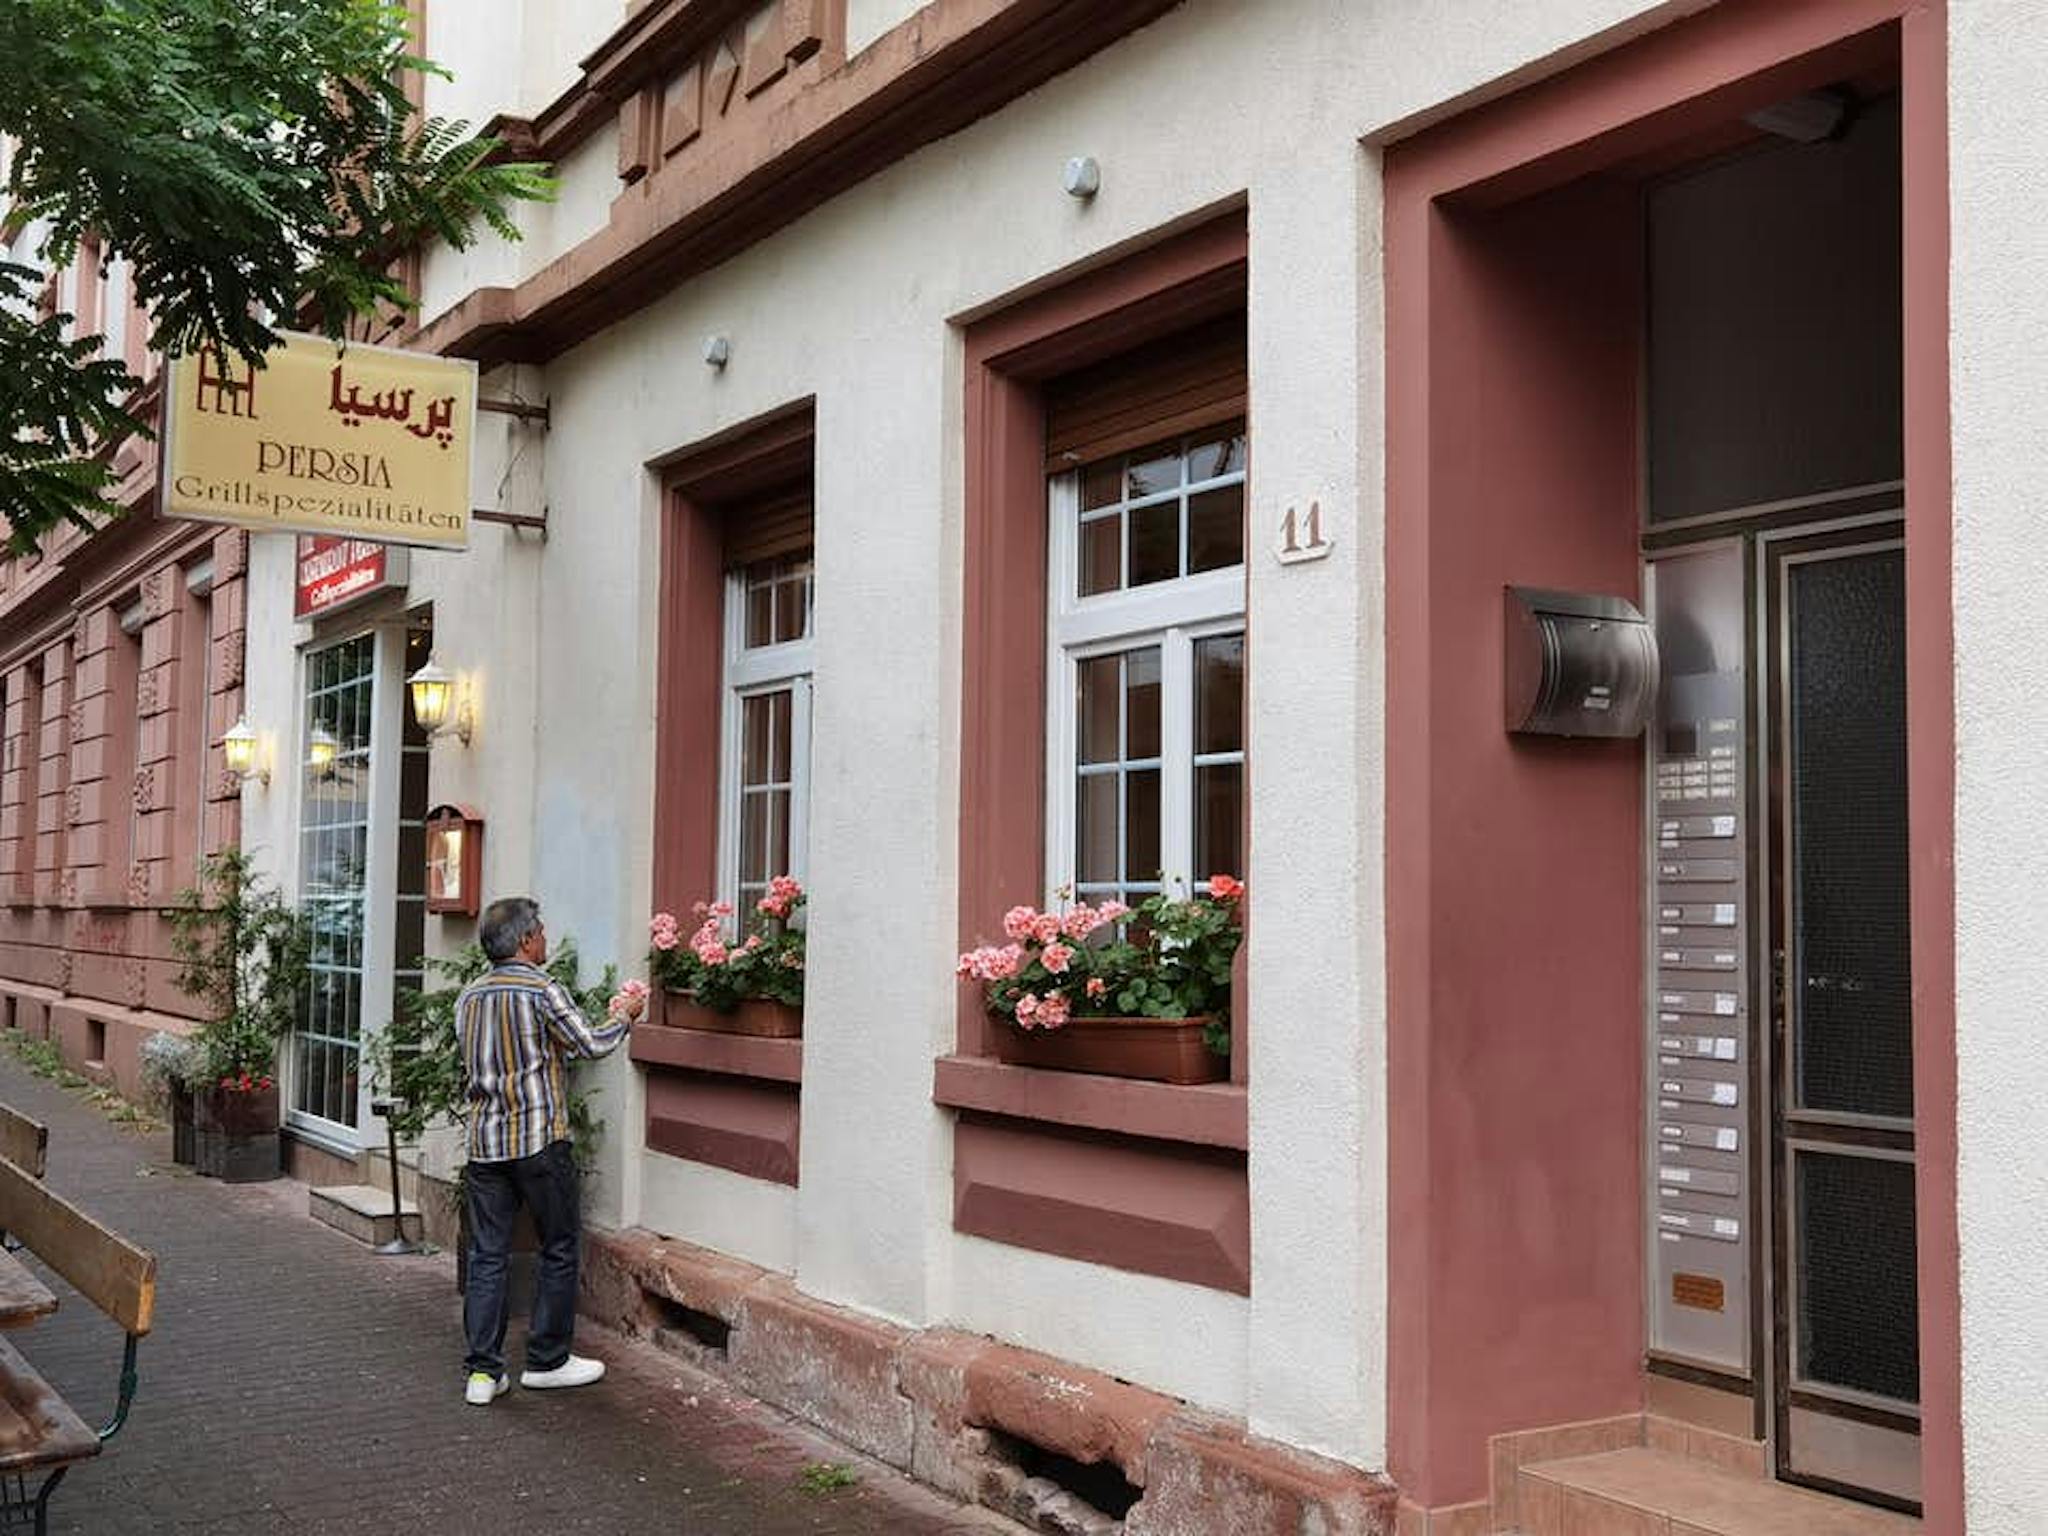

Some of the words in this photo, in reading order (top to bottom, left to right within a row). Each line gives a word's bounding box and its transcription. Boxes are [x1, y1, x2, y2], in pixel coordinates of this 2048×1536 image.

[256, 440, 393, 489] PERSIA
[174, 475, 463, 530] Grillspezialitäten
[1279, 501, 1327, 553] 11
